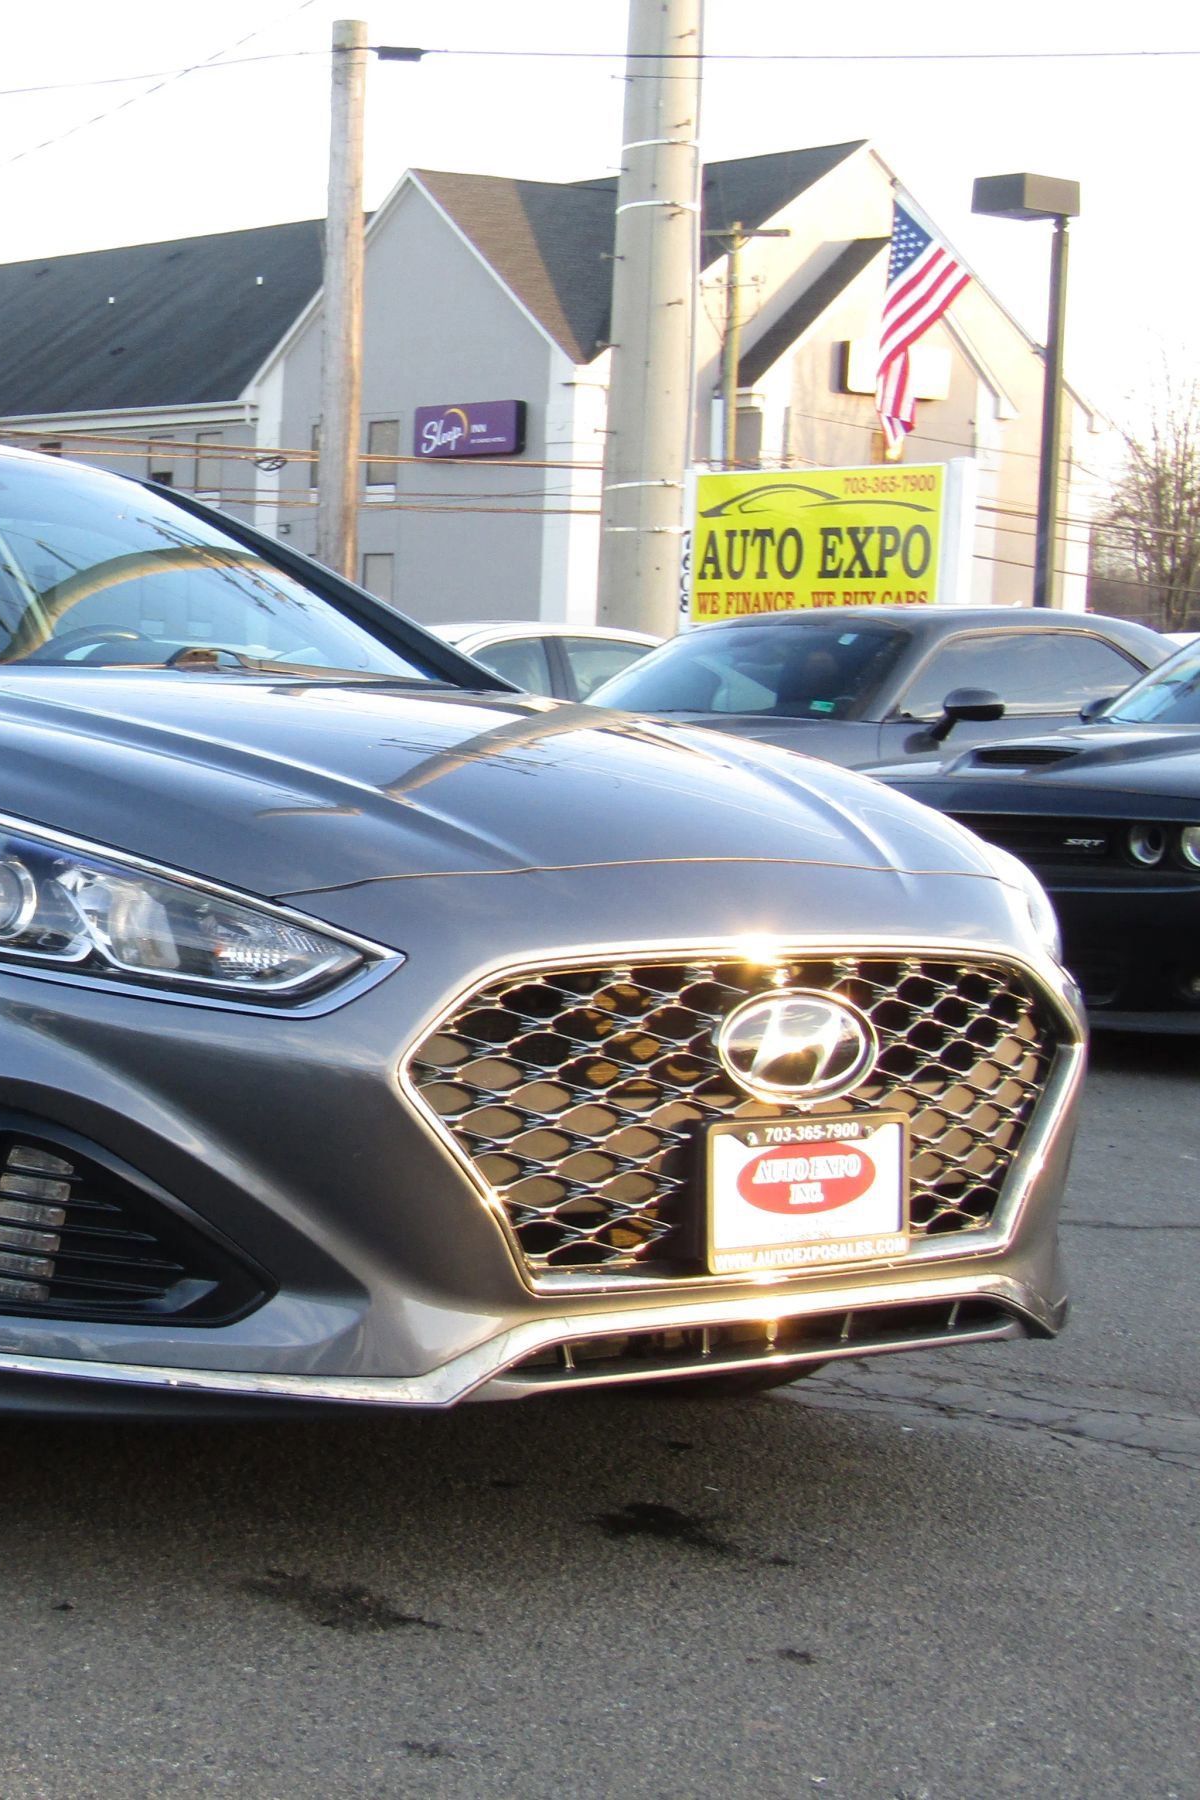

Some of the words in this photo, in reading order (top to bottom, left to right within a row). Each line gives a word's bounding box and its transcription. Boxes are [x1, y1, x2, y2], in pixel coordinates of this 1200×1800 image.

[421, 419, 463, 454] Sleep
[843, 475, 935, 494] 703-365-7900
[698, 527, 803, 580] AUTO
[817, 524, 932, 579] EXPO
[697, 592, 720, 615] WE
[724, 592, 795, 614] FINANCE
[811, 592, 836, 608] WE
[1064, 839, 1105, 848] SRT
[764, 1122, 859, 1143] 703-365-7900
[753, 1158, 808, 1184] AUTO
[808, 1154, 862, 1180] EXPO
[714, 1237, 907, 1271] WWW.AUTOEXPOSALES.COM
